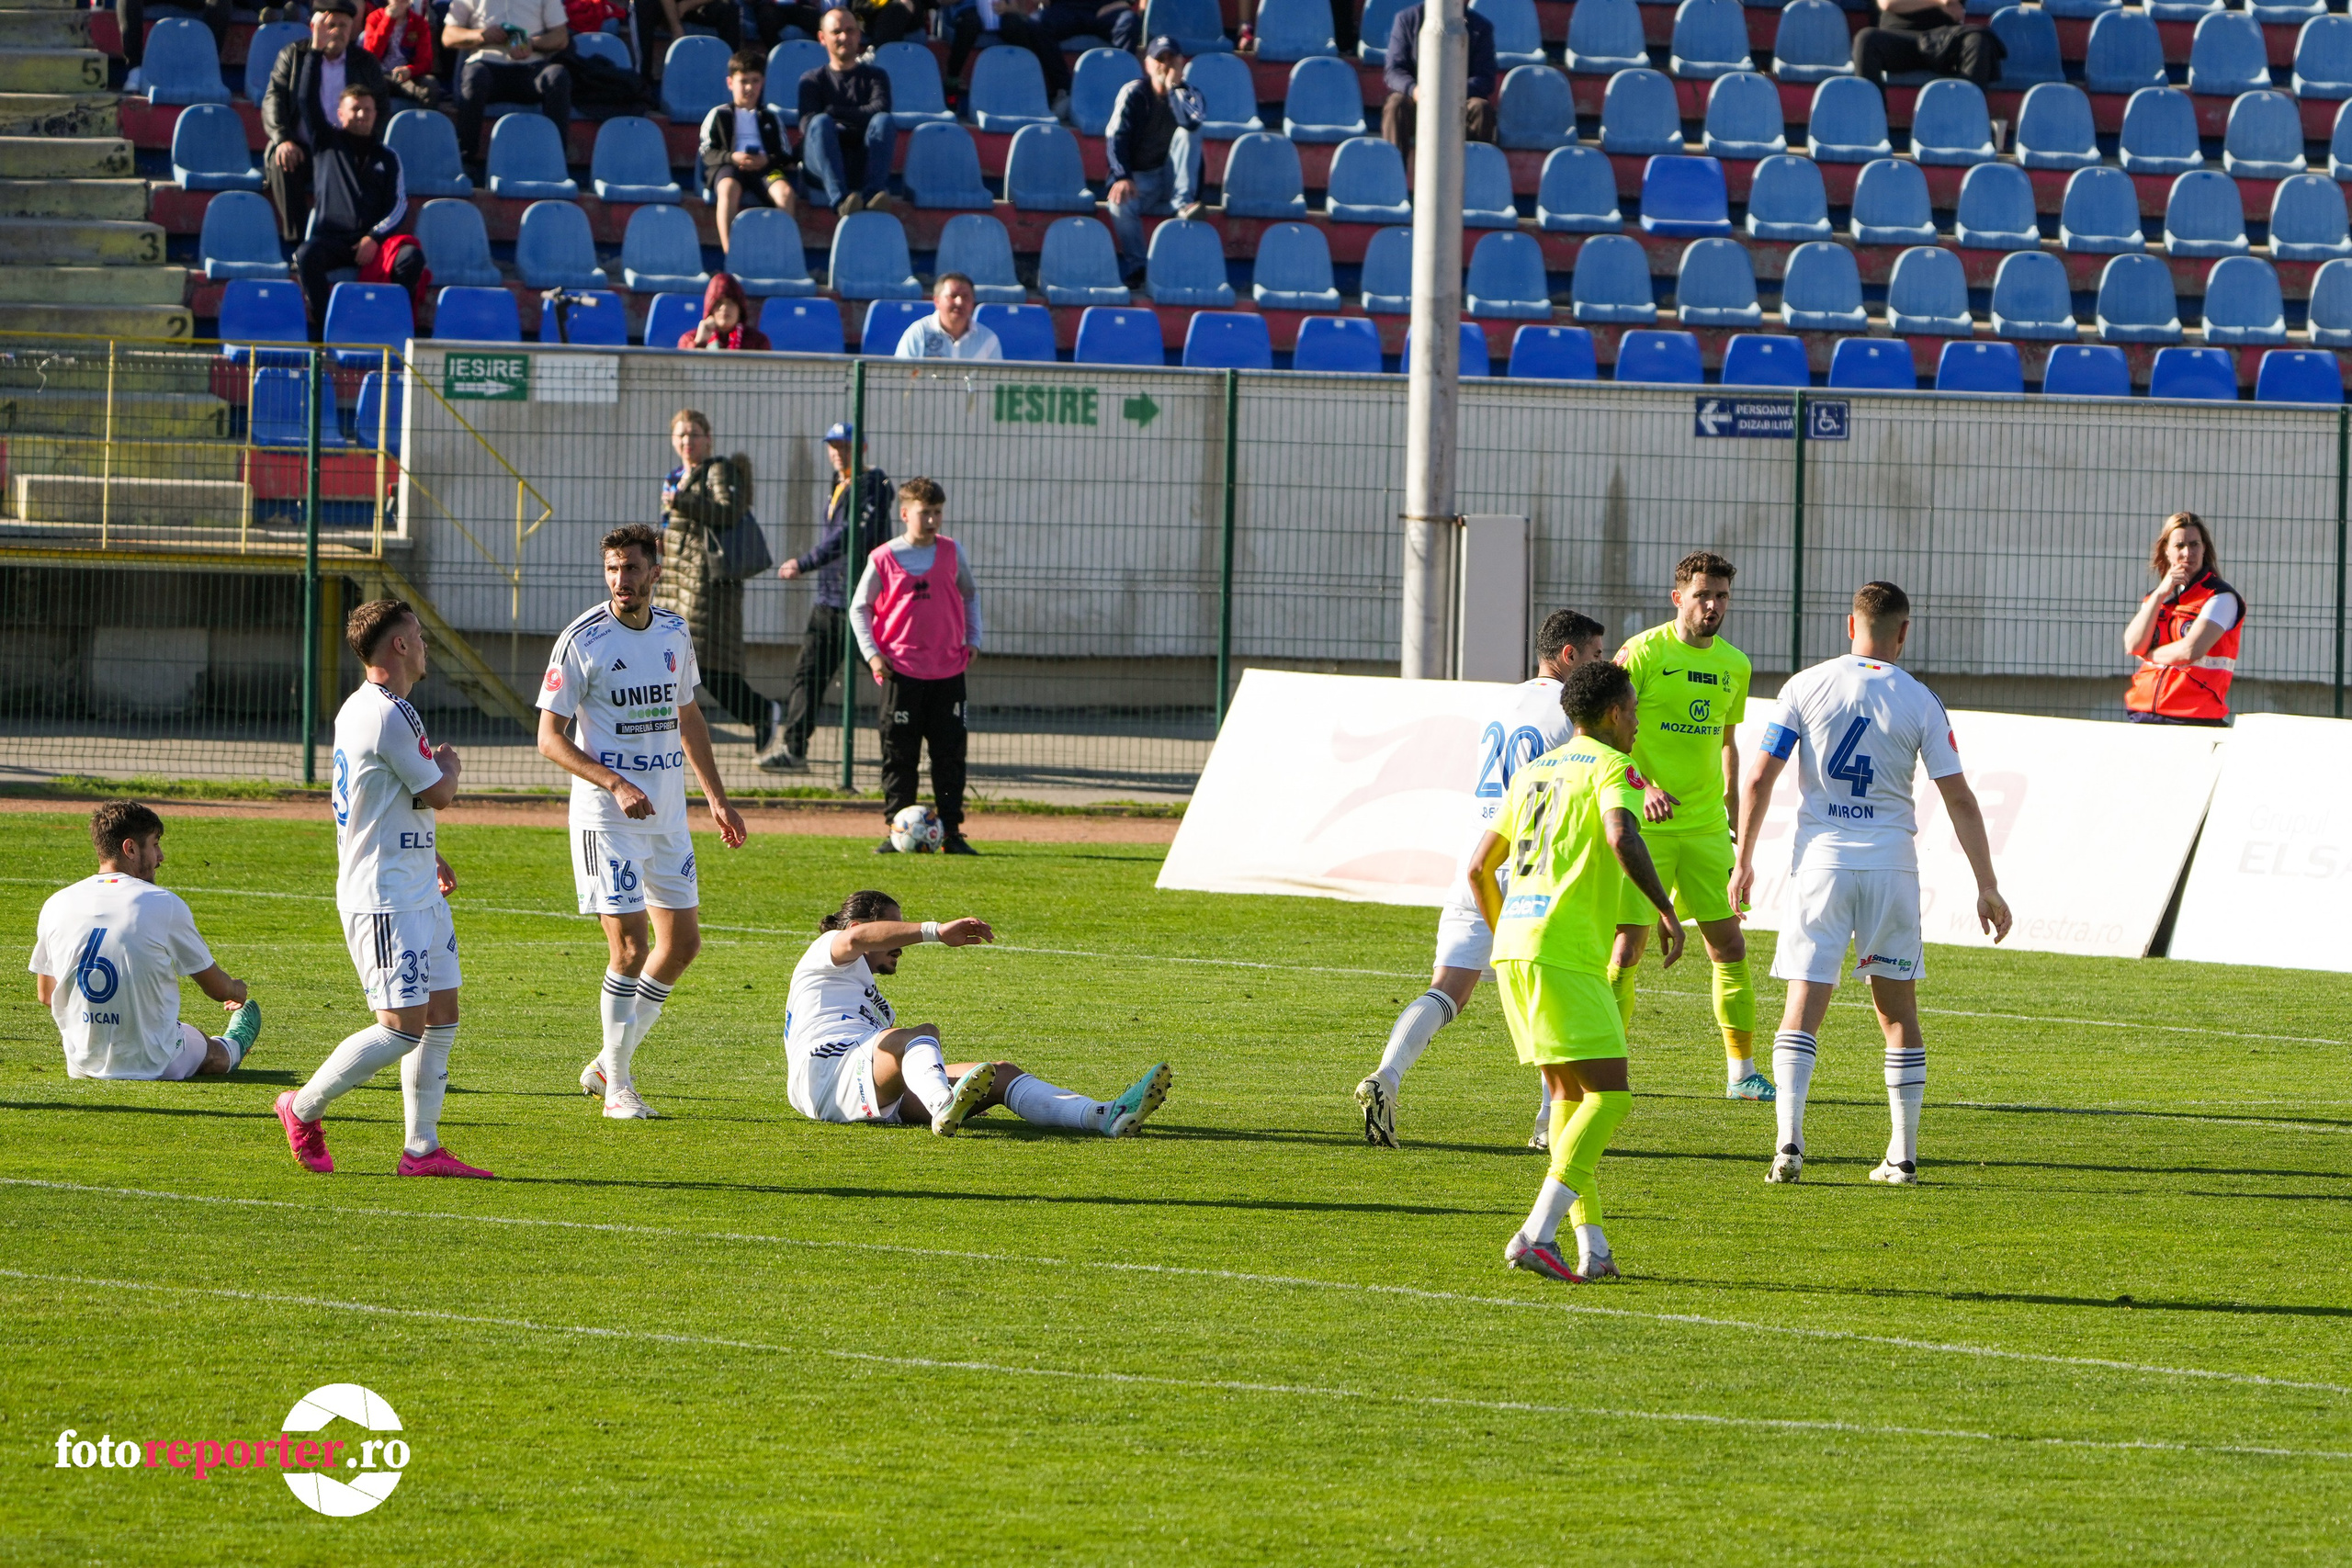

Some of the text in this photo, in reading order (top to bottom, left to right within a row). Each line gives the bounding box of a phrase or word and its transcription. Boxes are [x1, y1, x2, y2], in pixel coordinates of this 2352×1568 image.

[83, 57, 102, 85] 5
[140, 232, 160, 262] 3
[167, 316, 188, 344] 2
[448, 357, 524, 378] IESIRE
[995, 384, 1098, 425] IESIRE
[209, 408, 226, 436] 1
[611, 683, 677, 706] UNIBE
[894, 711, 909, 724] CS
[1660, 722, 1712, 735] MOZZART
[600, 750, 683, 772] ELSACO
[1475, 721, 1544, 798] 20
[1827, 716, 1874, 797] 4
[1828, 803, 1873, 819] MIRON
[2249, 804, 2331, 840] Grupul
[610, 860, 637, 892] 16
[77, 928, 119, 1004] 6
[401, 950, 429, 984] 33
[1871, 954, 1897, 965] Smart
[83, 1011, 119, 1025] DICAN
